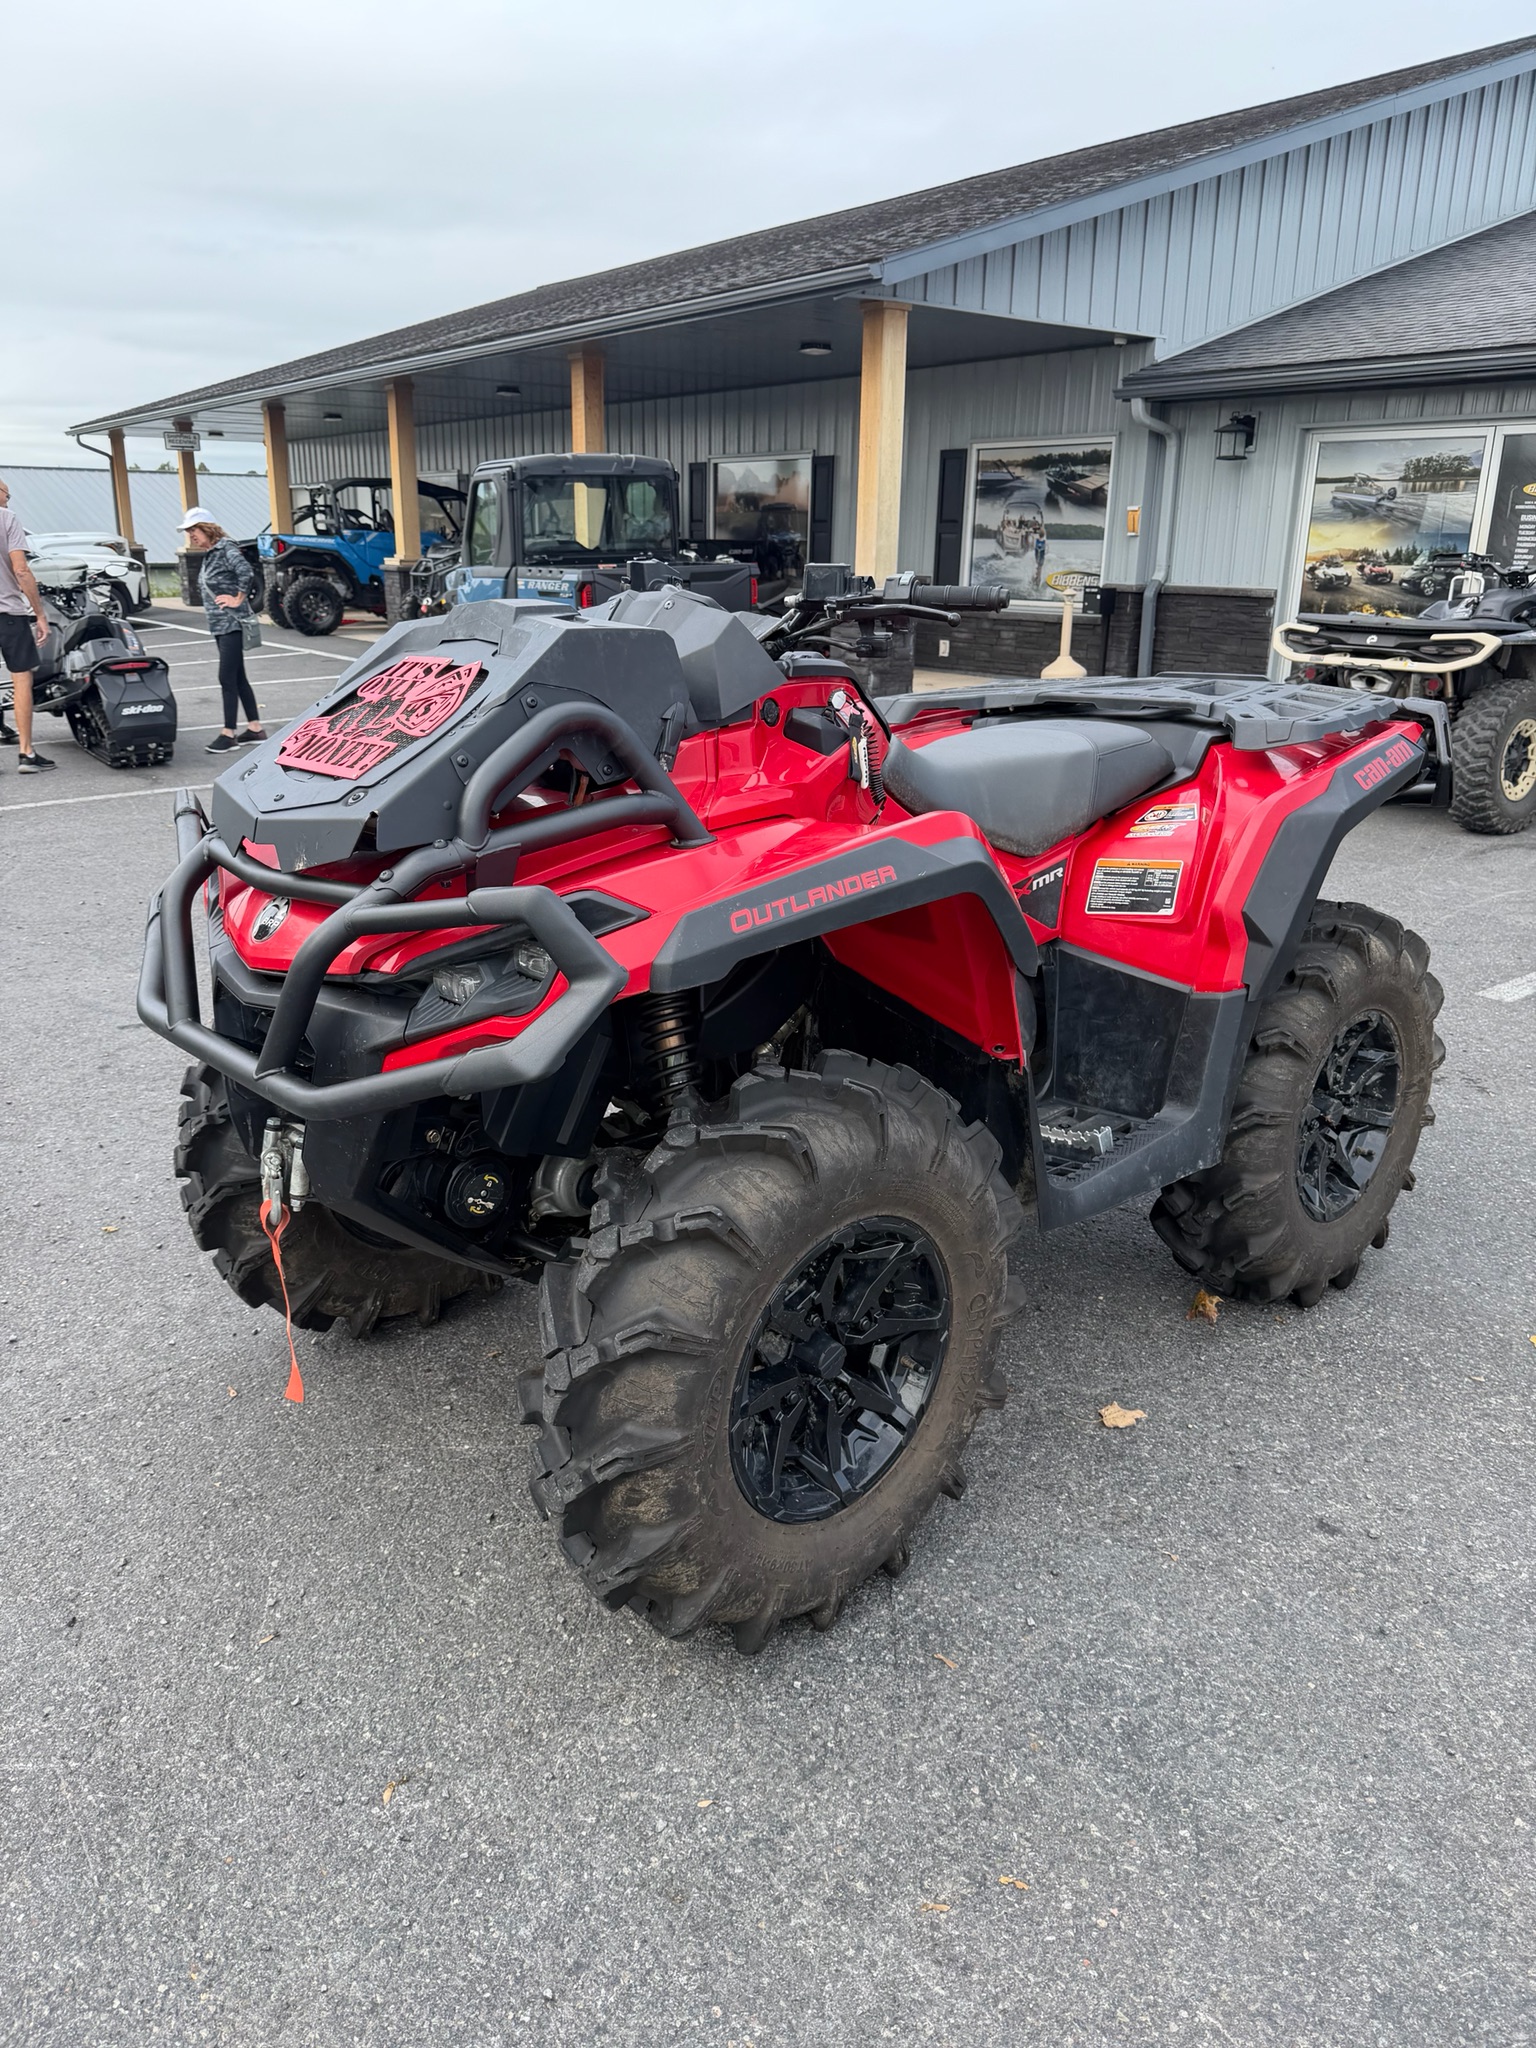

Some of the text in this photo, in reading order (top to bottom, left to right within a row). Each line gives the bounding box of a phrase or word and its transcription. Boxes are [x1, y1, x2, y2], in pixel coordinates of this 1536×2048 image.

[527, 581, 570, 591] RANGER
[1052, 575, 1099, 587] BIBBENS
[384, 661, 442, 680] IT'S
[359, 676, 427, 698] ONLY
[121, 704, 164, 715] ski-doo
[285, 733, 393, 772] MONEY!
[729, 865, 898, 934] OUTLANDER
